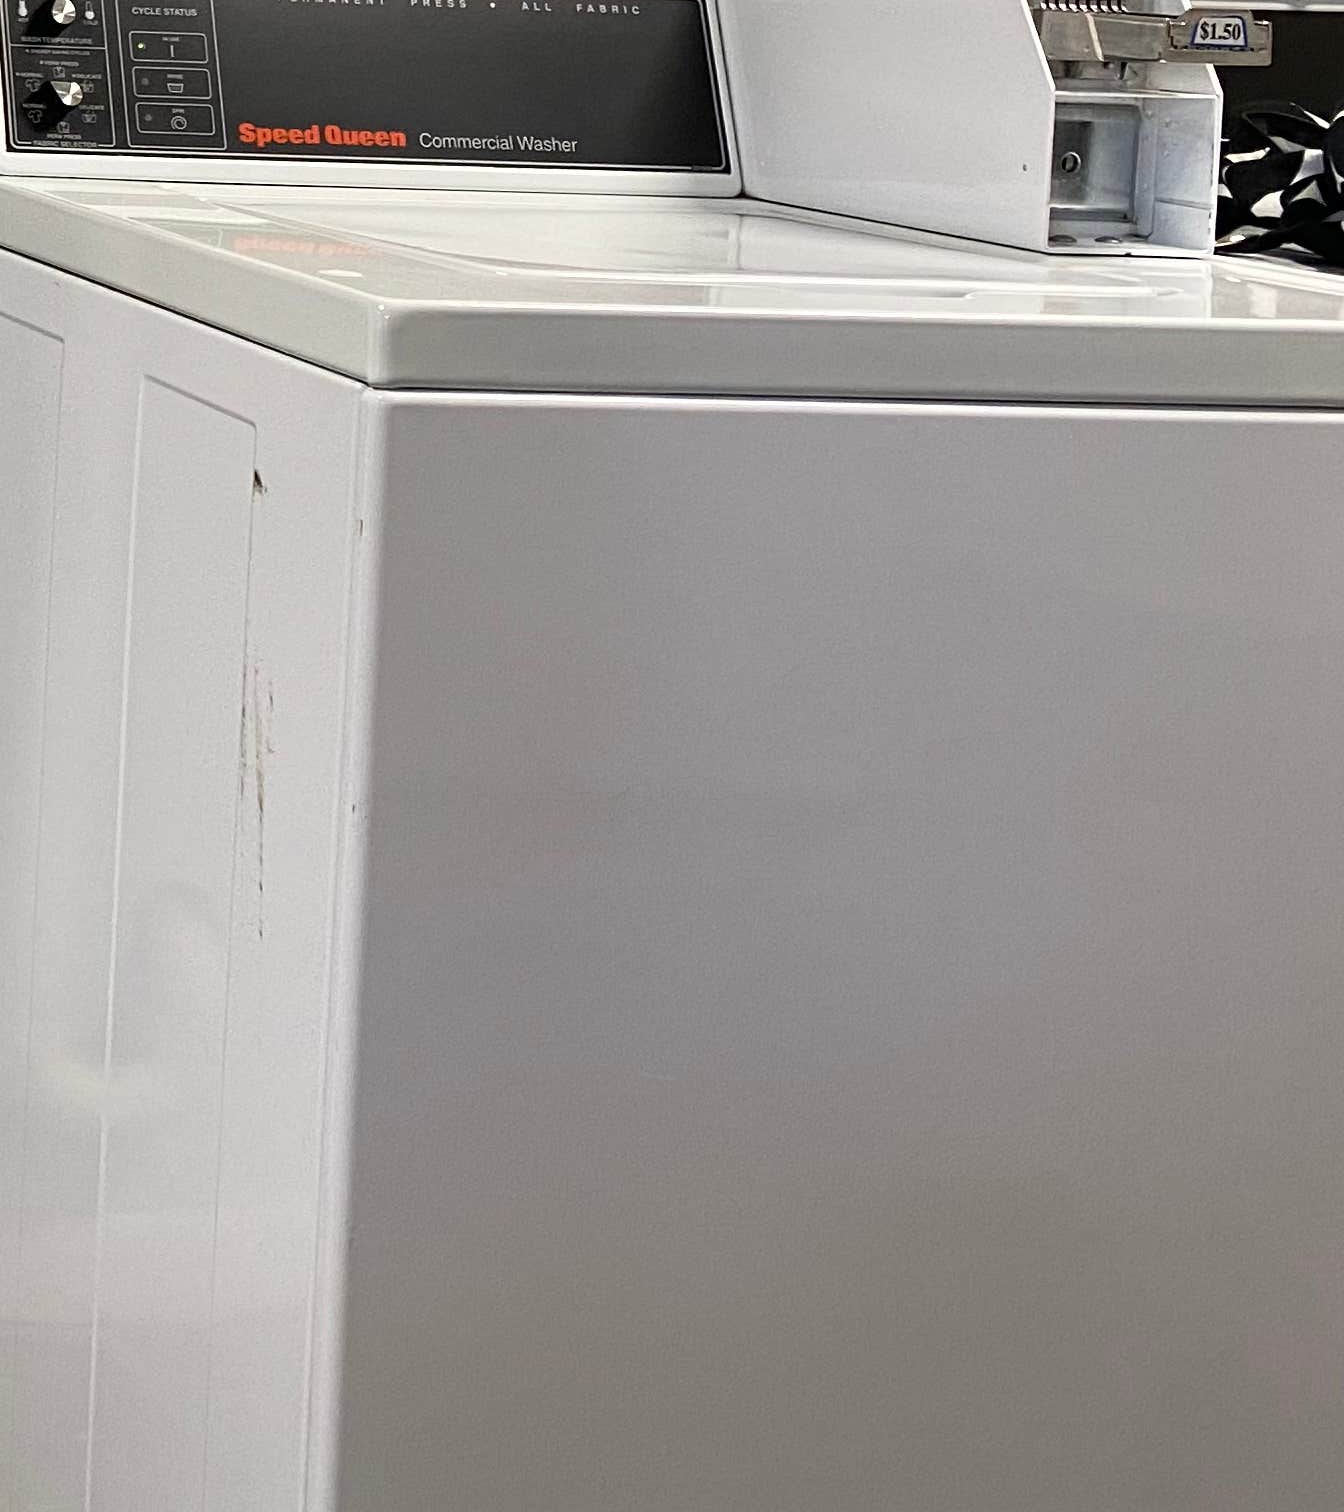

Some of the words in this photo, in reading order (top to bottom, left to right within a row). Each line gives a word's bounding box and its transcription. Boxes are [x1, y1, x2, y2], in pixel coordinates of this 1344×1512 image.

[132, 6, 161, 15] CYCLE
[162, 7, 198, 17] STATUS
[521, 1, 553, 12] ALL
[575, 3, 641, 15] FABRIC
[1199, 21, 1242, 42] $1.50
[239, 122, 320, 148] Speed
[324, 124, 407, 148] Queen
[419, 132, 514, 151] Commercial
[516, 135, 578, 153] Washer
